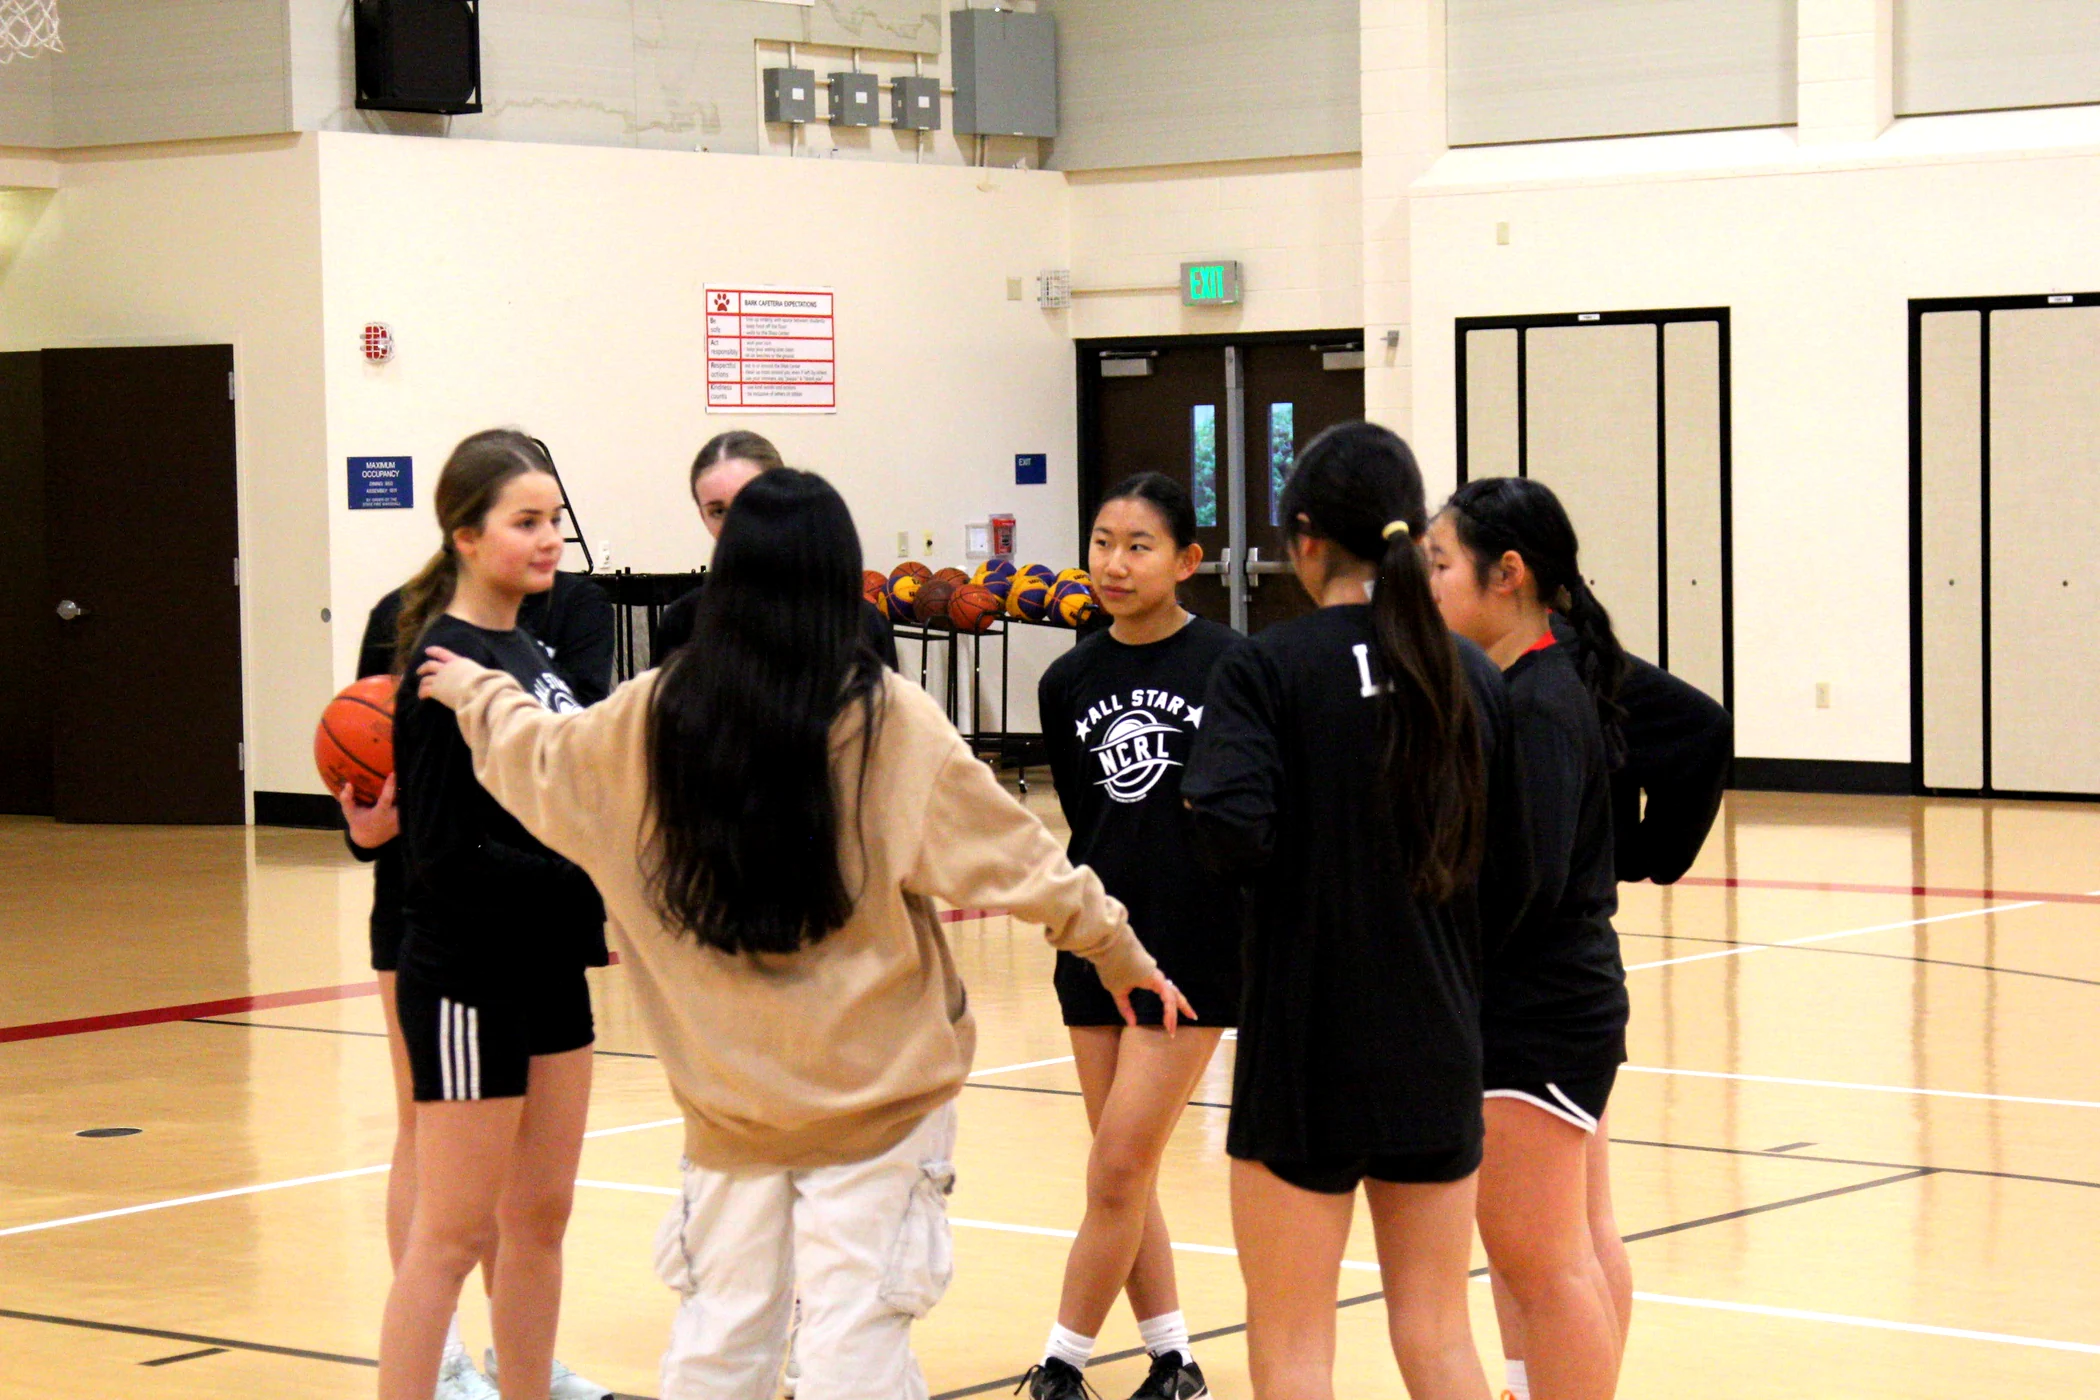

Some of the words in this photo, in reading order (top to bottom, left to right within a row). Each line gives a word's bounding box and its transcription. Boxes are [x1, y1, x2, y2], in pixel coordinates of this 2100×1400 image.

[1189, 265, 1225, 300] EXIT
[711, 348, 738, 356] responsibly
[362, 470, 400, 478] OCCUPANCY
[1088, 694, 1123, 725] ALL
[1131, 689, 1185, 715] STAR
[1098, 732, 1169, 776] NCRL
